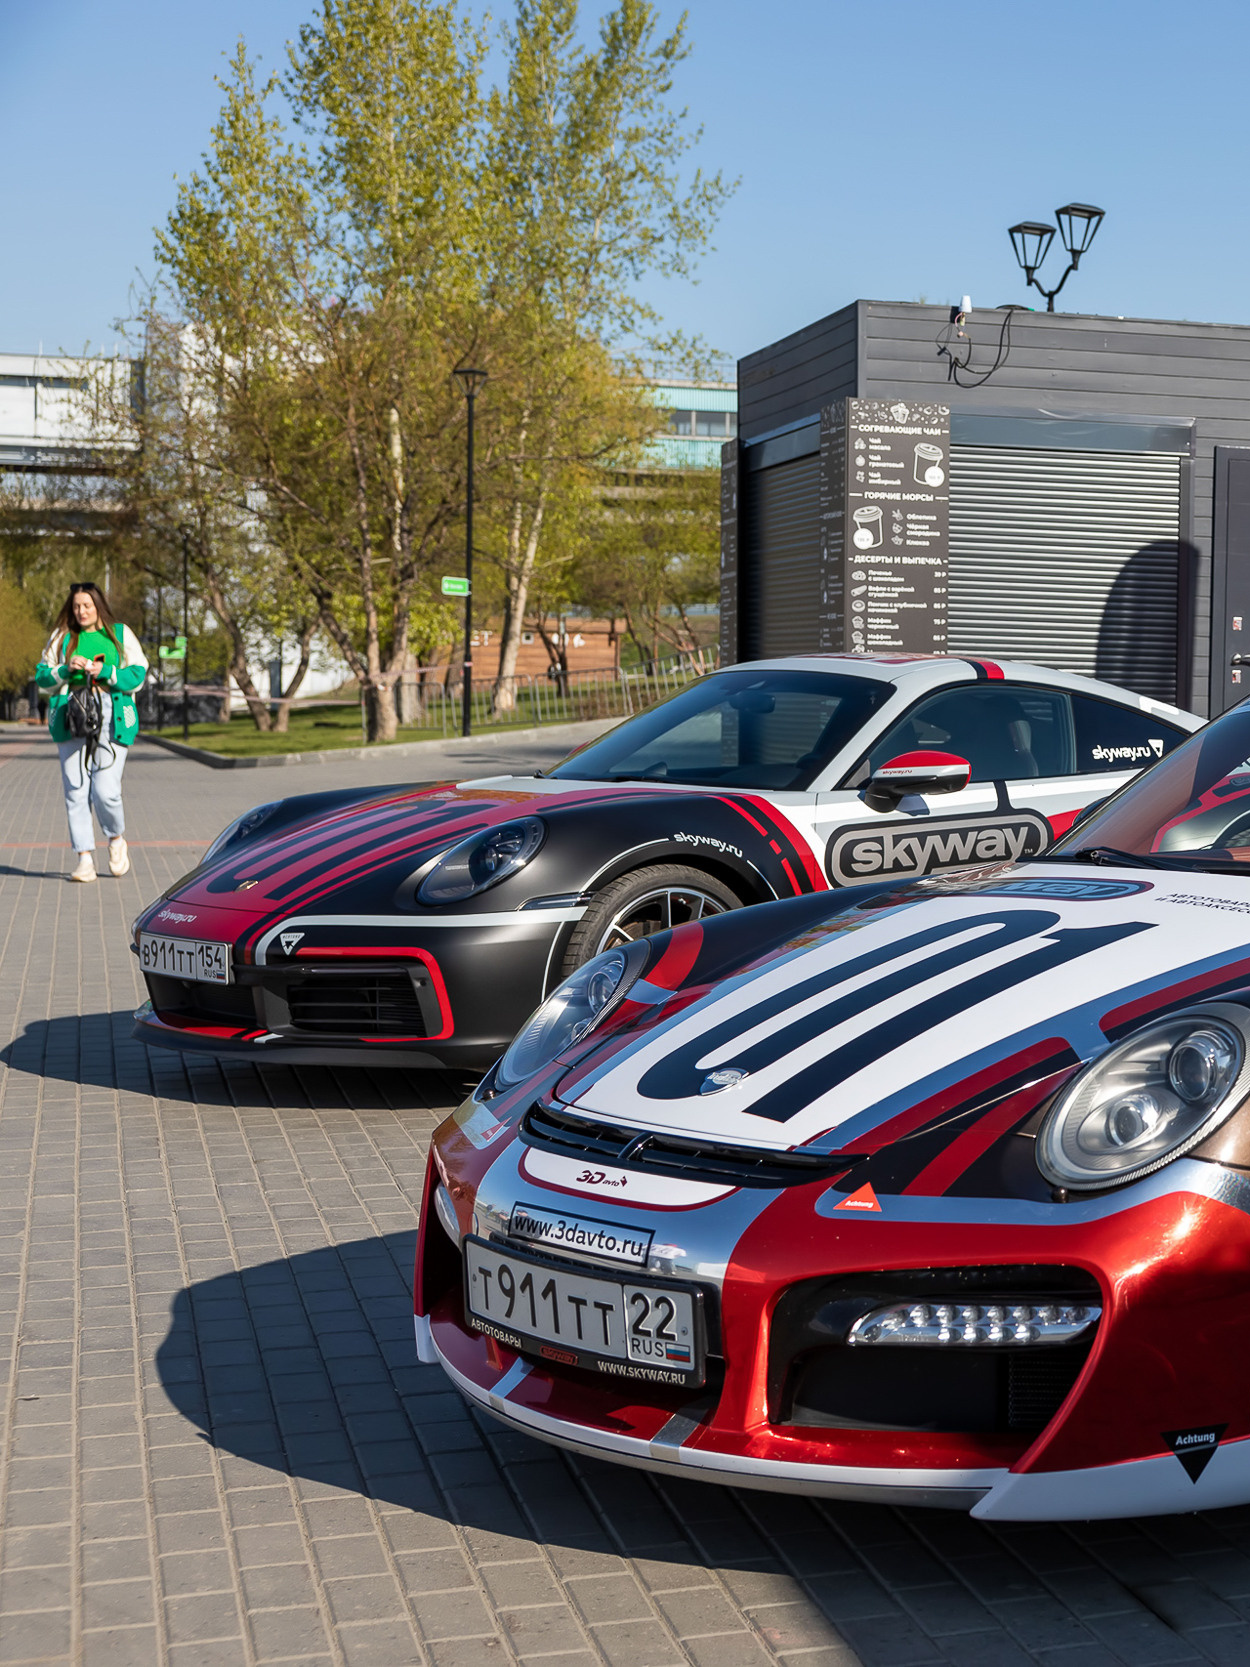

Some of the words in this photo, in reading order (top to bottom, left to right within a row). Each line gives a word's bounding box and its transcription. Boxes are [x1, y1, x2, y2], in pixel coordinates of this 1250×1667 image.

[858, 424, 922, 436] СОГРЕВАЮЩИЕ
[864, 491, 902, 501] ГОРЯЧИЕ
[902, 493, 934, 502] МОРСЫ
[853, 554, 893, 564] ДЕСЕРТЫ
[894, 556, 901, 564] И
[902, 556, 943, 565] ВЫПЕЧКА
[1092, 745, 1151, 763] skyway.ru
[673, 832, 743, 858] skyway.ru
[851, 826, 1029, 873] skyway
[157, 908, 198, 924] skyway.ru
[198, 945, 222, 970] 154
[203, 970, 217, 978] RUS
[637, 909, 1160, 1124] 01
[576, 1169, 606, 1185] 3D
[514, 1213, 644, 1257] www.3davto.ru
[630, 1292, 678, 1342] 22
[471, 1317, 523, 1349] АВТОТОВАРЫ
[631, 1337, 665, 1358] RUS
[597, 1360, 686, 1385] WWW.SKYWAY.RU
[1175, 1432, 1216, 1446] Achtung
